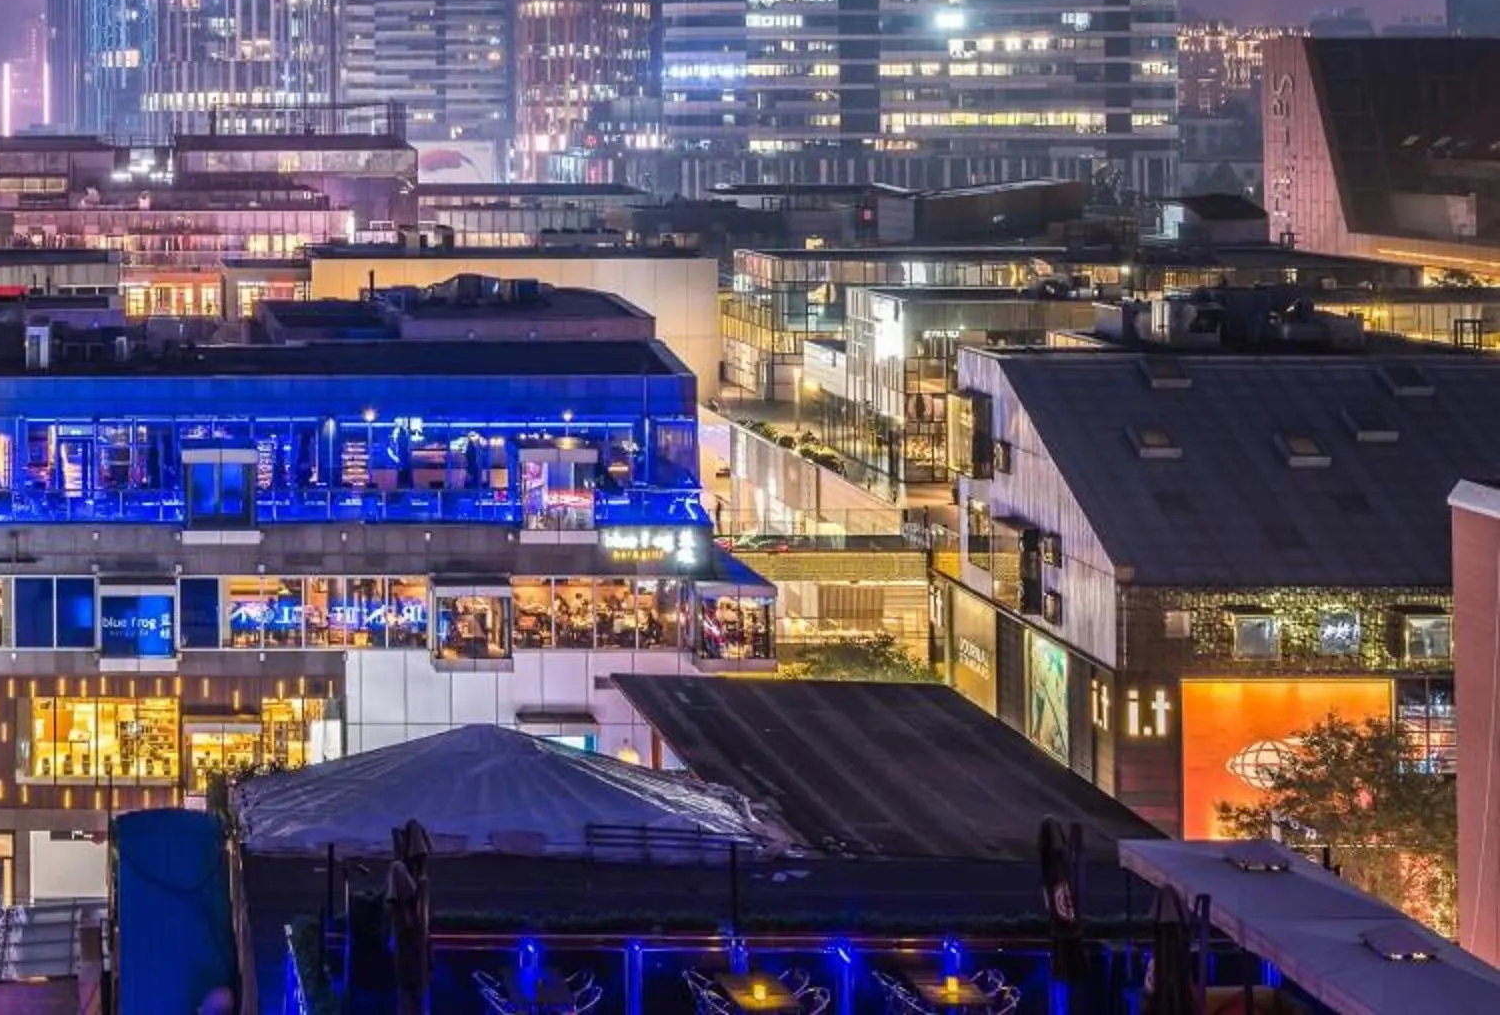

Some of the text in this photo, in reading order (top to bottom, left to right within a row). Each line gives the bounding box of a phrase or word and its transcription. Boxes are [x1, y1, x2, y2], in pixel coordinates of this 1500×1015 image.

[101, 616, 157, 631] blue frog
[1092, 679, 1110, 731] i.t
[1127, 689, 1171, 737] i.t
